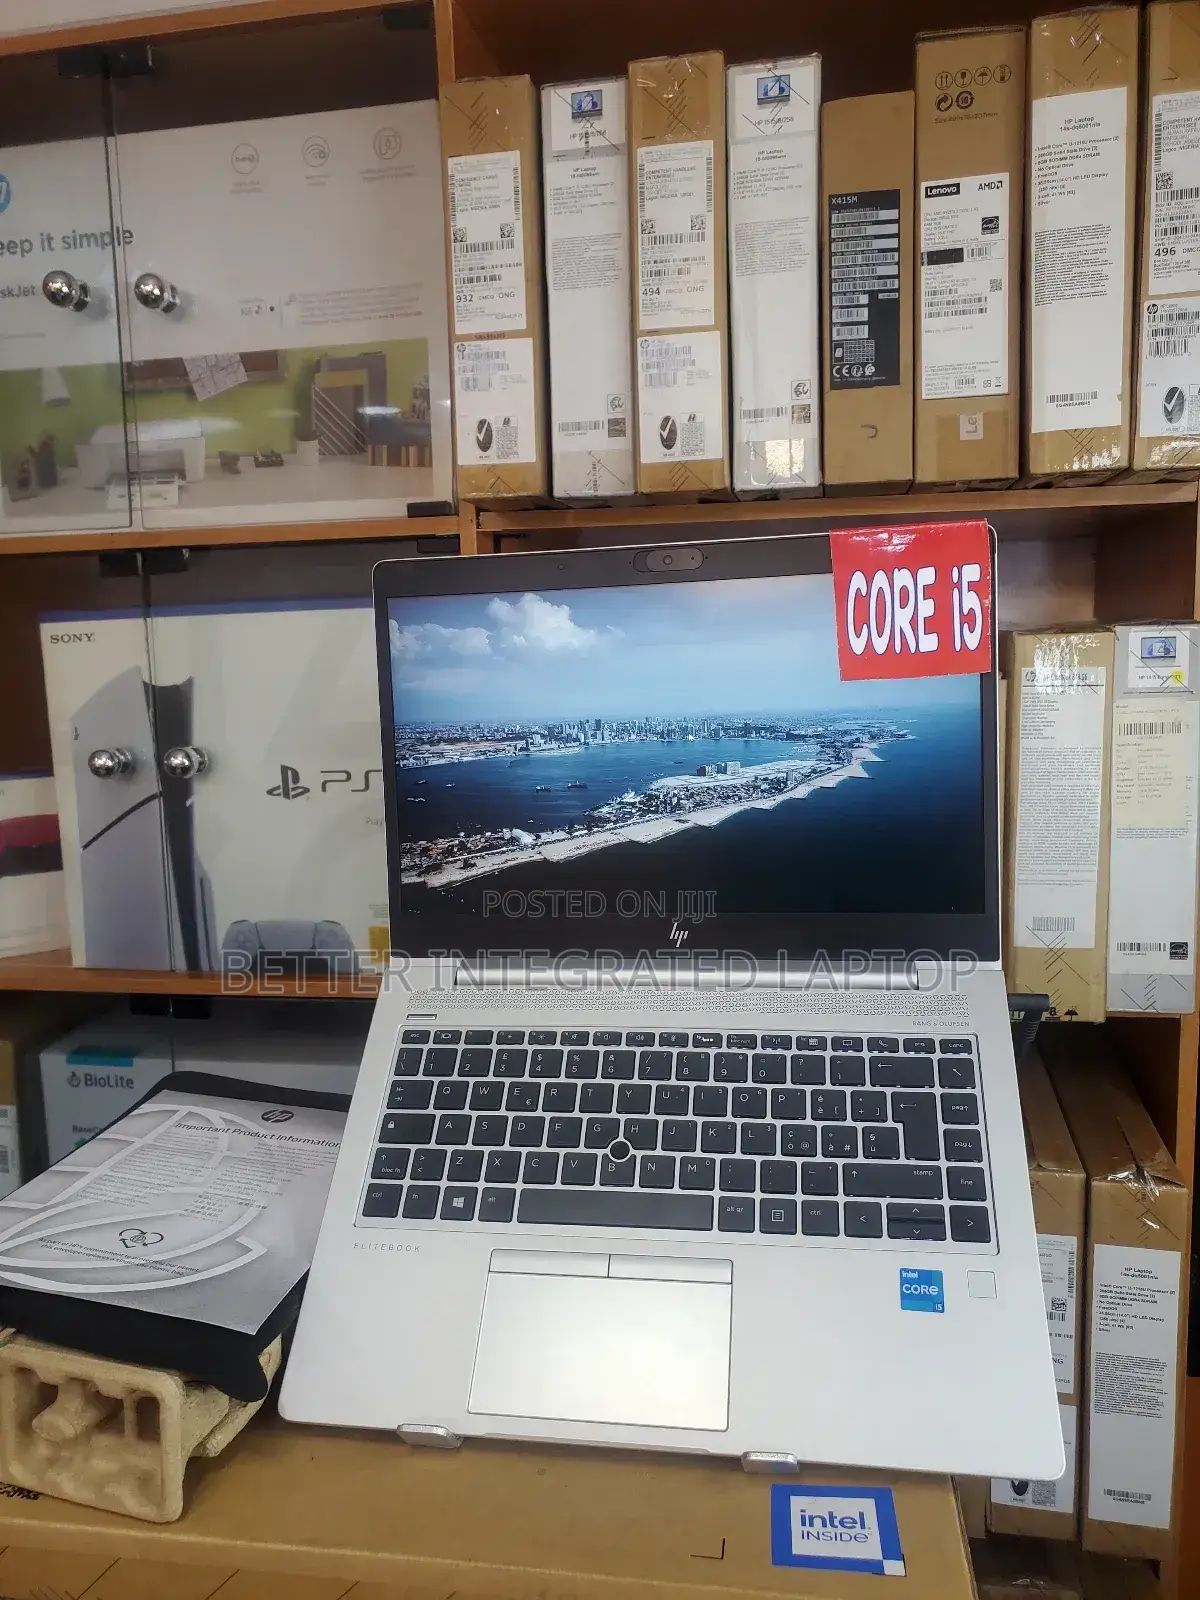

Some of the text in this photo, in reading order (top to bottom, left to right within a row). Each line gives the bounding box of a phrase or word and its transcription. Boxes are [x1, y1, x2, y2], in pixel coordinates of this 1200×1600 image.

[927, 186, 957, 195] Lenovo
[978, 182, 996, 191] AMD
[831, 196, 858, 204] X415M
[40, 232, 54, 252] it
[61, 226, 134, 251] simple
[1154, 247, 1176, 257] 496
[642, 287, 660, 296] 494
[456, 294, 473, 303] 932
[846, 562, 983, 655] CORE i5
[50, 633, 94, 644] SONY
[670, 923, 688, 947] hp
[84, 1073, 134, 1089] BioLite
[72, 1125, 103, 1133] BaseC
[175, 1122, 341, 1148] Important Product Information
[913, 1169, 933, 1177] stamp
[46, 1238, 61, 1246] part
[83, 1246, 123, 1257] commitment
[353, 1242, 421, 1252] ELITEBOOK
[53, 1246, 82, 1255] envelope
[149, 1264, 171, 1272] plastic
[902, 1270, 918, 1279] intel
[935, 1303, 942, 1311] i5
[800, 1510, 866, 1530] intel
